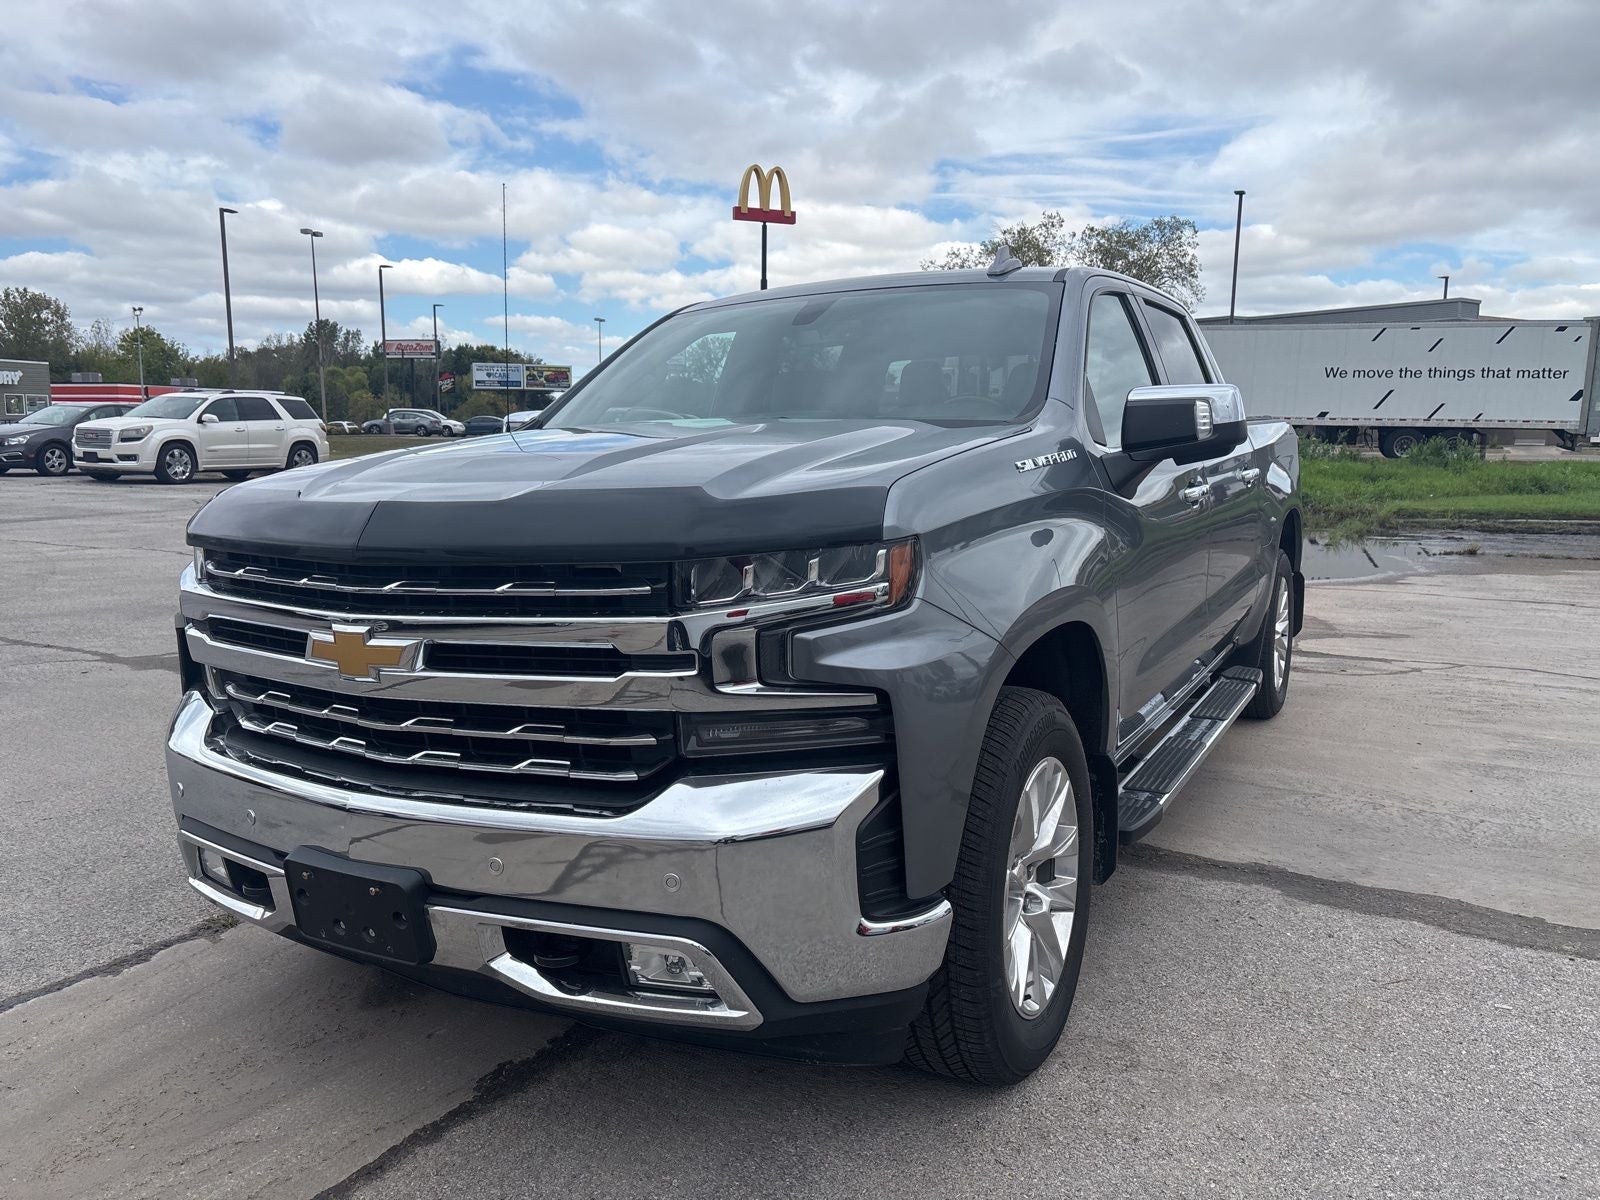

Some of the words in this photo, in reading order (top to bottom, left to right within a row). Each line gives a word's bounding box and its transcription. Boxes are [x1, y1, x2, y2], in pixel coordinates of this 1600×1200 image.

[395, 342, 433, 351] AutoZone
[1324, 366, 1348, 379] We
[1352, 368, 1394, 379] move
[1398, 367, 1423, 379] the
[1427, 367, 1476, 381] things
[1480, 367, 1511, 379] that
[1516, 368, 1570, 380] matter
